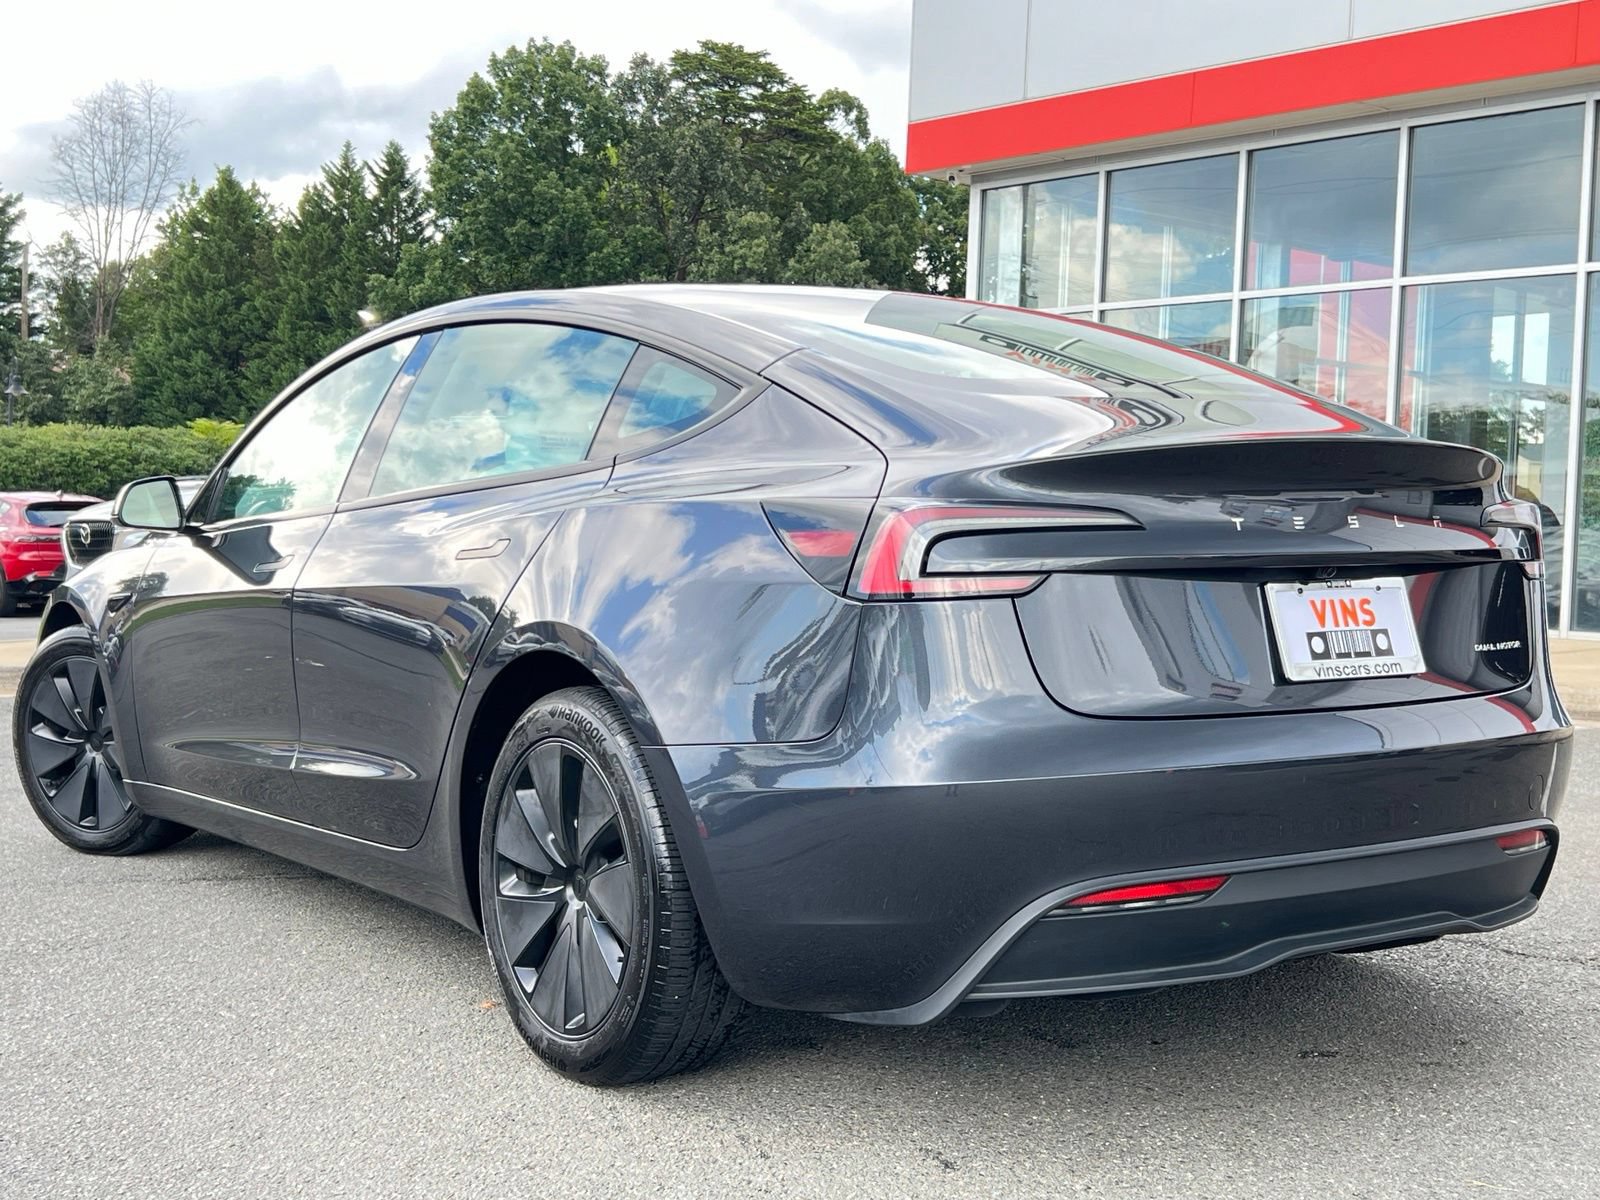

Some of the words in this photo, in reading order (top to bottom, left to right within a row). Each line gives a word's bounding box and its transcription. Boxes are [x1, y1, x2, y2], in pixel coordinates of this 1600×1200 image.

[1231, 515, 1442, 531] TESLA
[1309, 598, 1376, 628] VINS
[1313, 662, 1403, 678] vinscars.com
